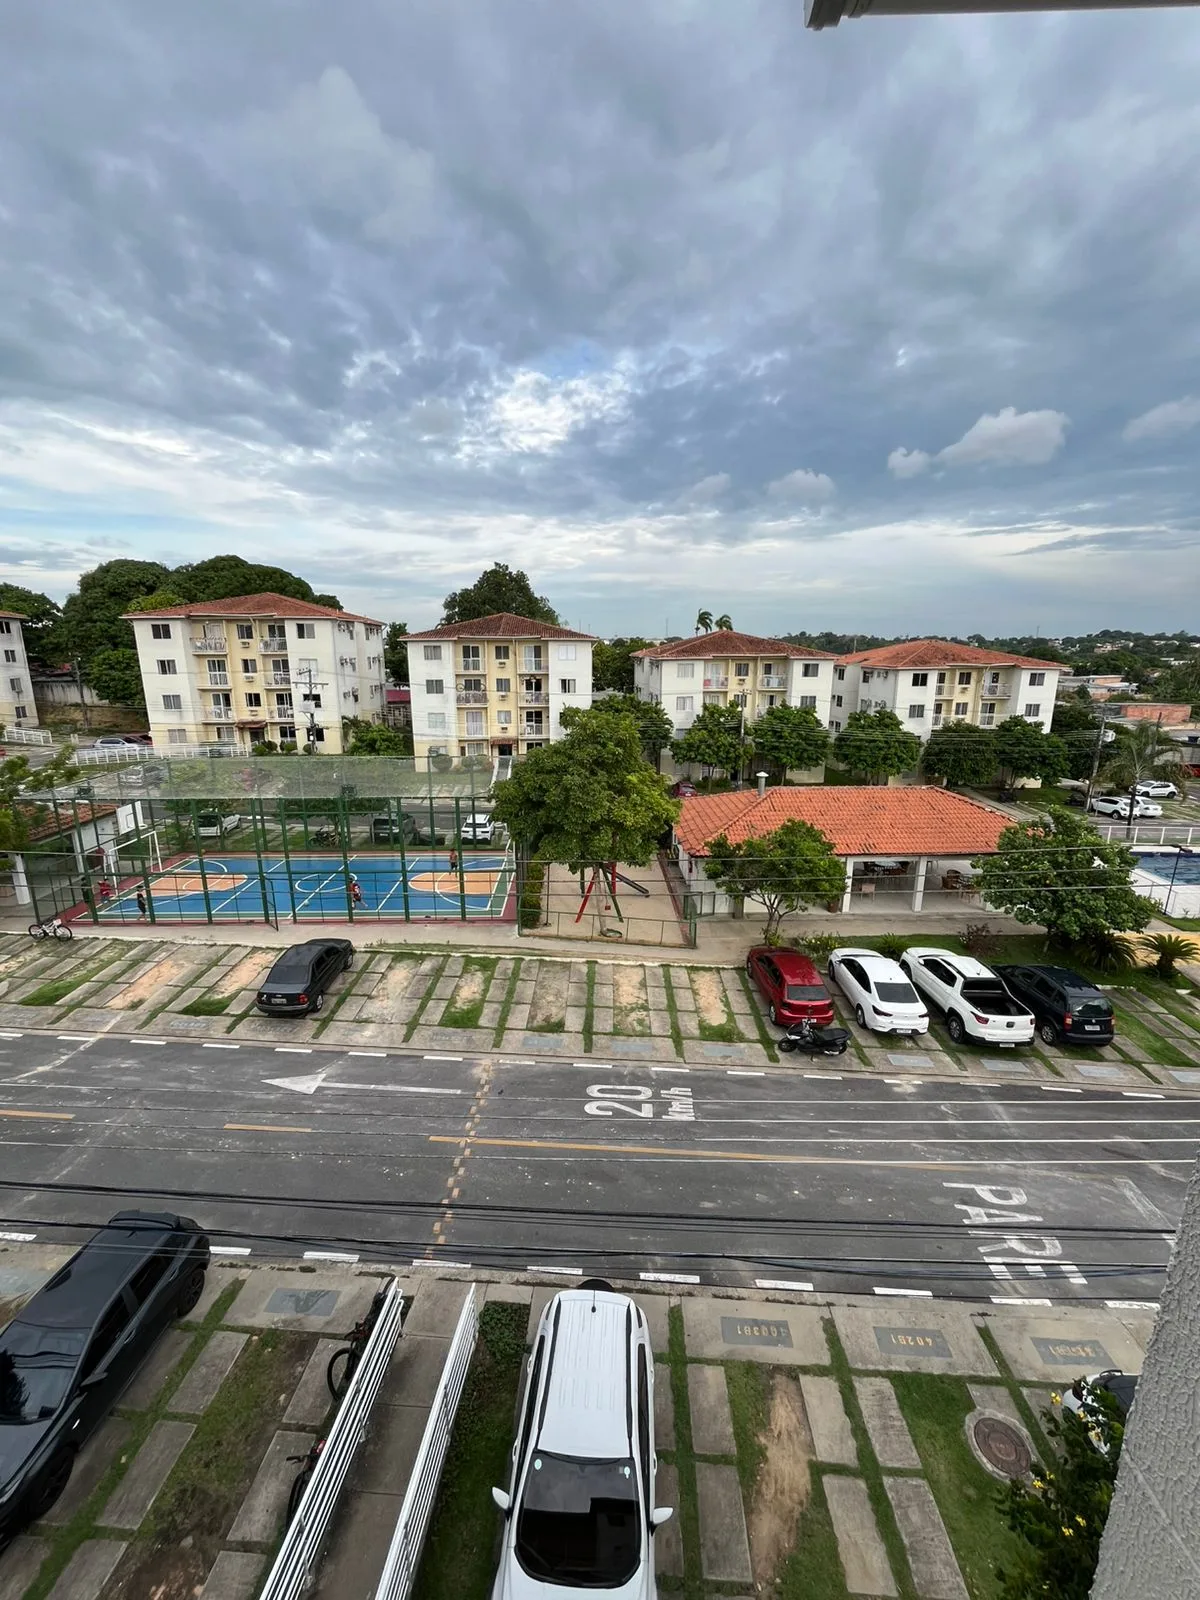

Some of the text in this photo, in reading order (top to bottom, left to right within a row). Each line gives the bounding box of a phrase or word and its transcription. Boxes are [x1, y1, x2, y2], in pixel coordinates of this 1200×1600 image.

[584, 1084, 653, 1118] 20
[660, 1087, 695, 1120] km/h
[942, 1182, 1088, 1285] PARE
